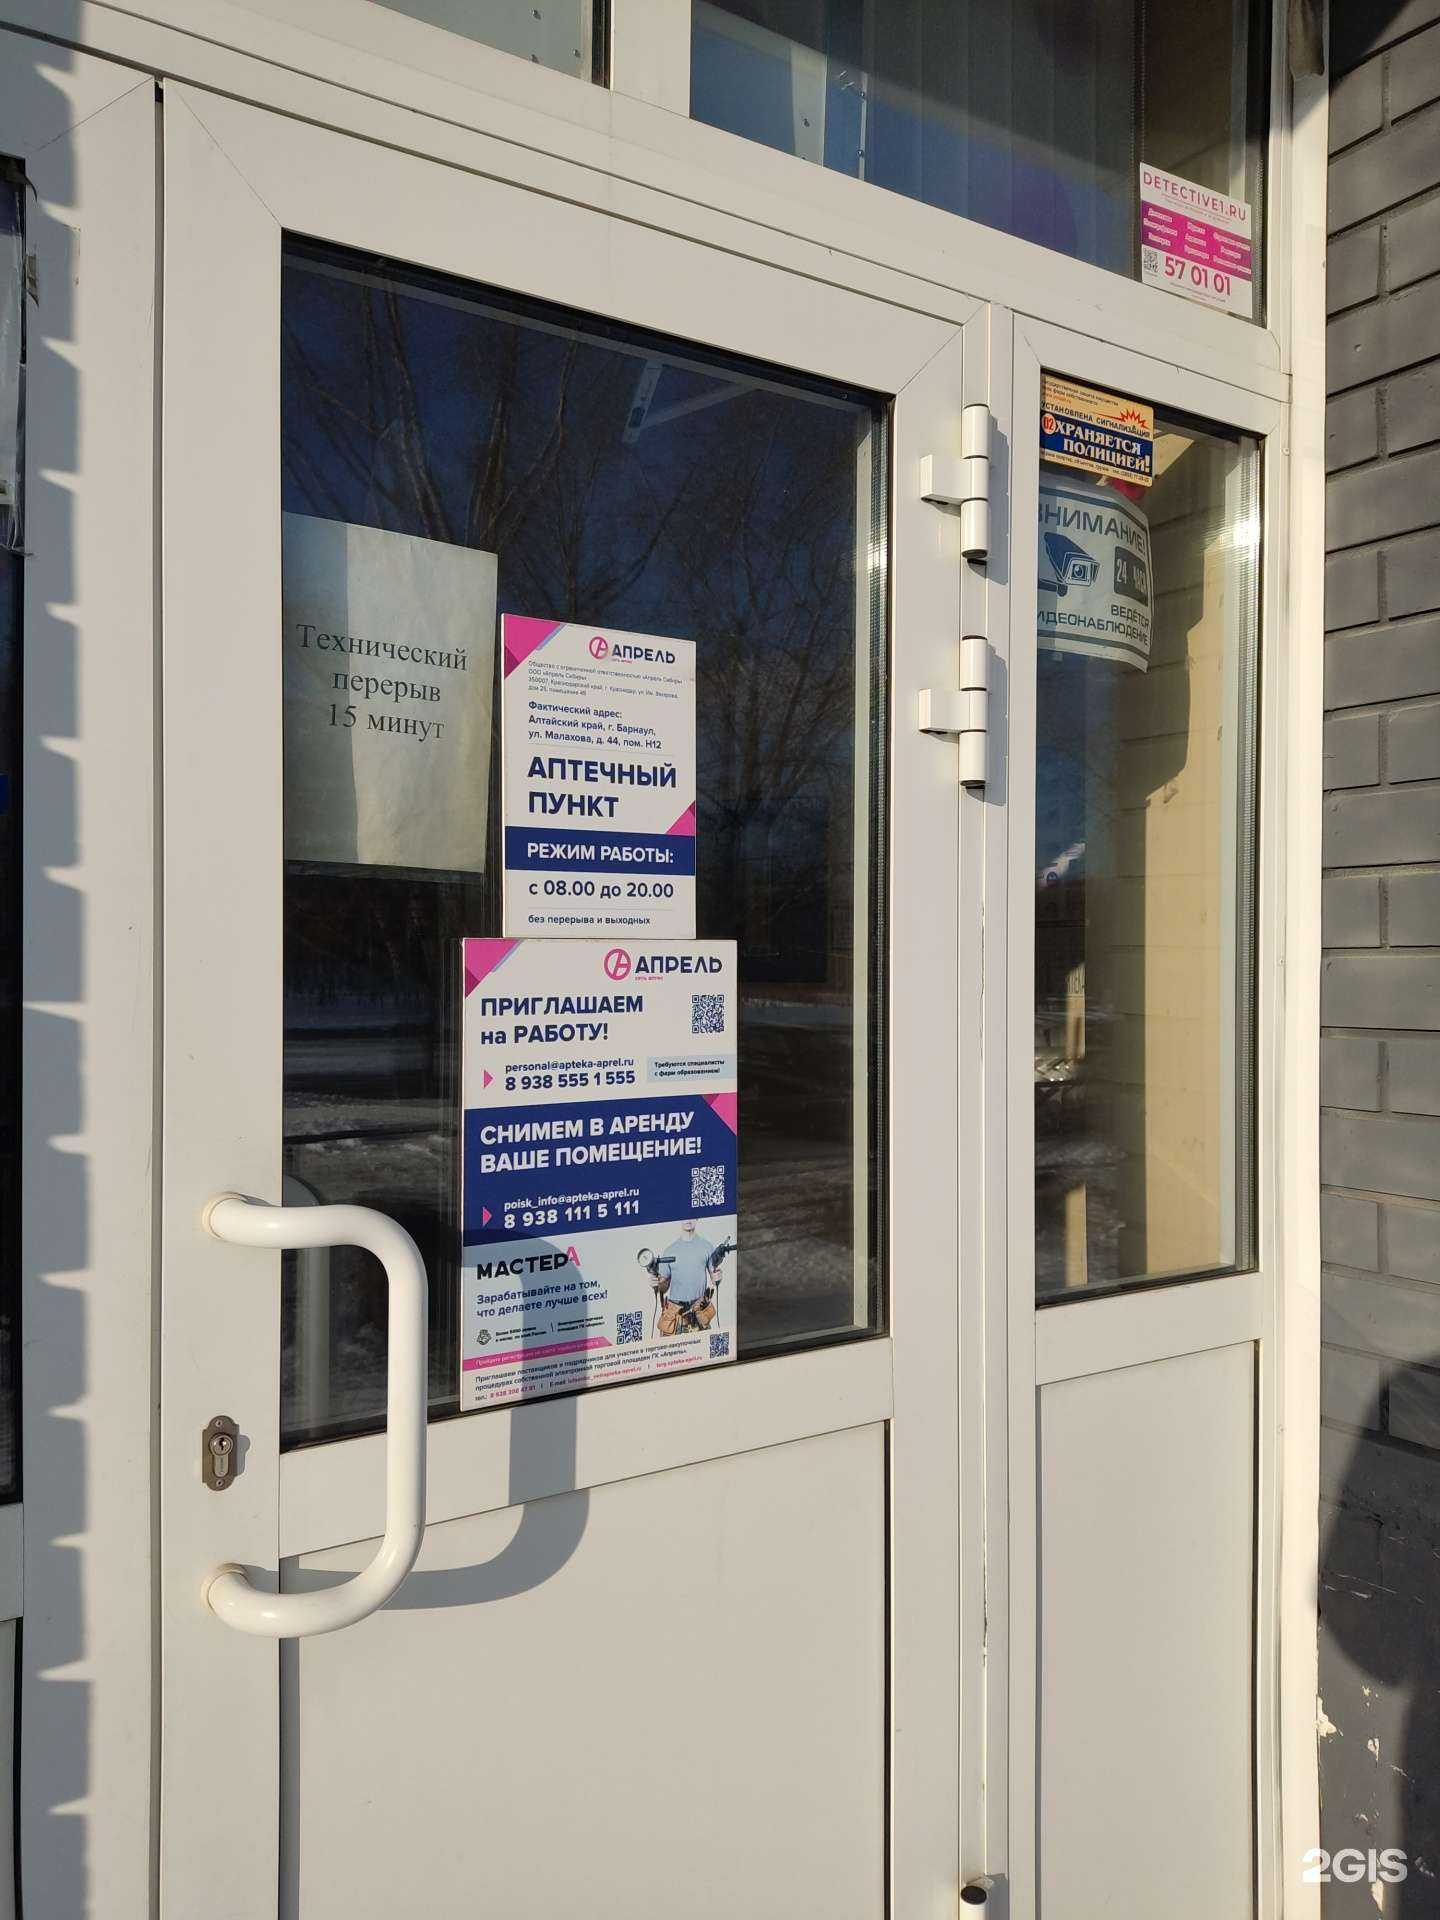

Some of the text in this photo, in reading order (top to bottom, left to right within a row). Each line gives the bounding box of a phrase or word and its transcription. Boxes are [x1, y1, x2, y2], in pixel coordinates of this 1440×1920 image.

[1144, 172, 1246, 221] DETECTIVE1.RU
[1164, 256, 1186, 280] 57
[1191, 265, 1208, 288] 01
[1214, 272, 1232, 296] 01
[1041, 402, 1151, 438] УСТАНОВЛЕНА СИГНАЛИЗАЦИЯ
[1064, 439, 1151, 474] ПОЛИЦИЕЙ!
[1116, 558, 1127, 584] 24
[1037, 611, 1149, 646] ИДЕОНАБЛЮДЕНИЕ
[296, 623, 468, 670] Технический
[611, 643, 676, 665] АПРЕЛЬ
[333, 672, 441, 703] перерыв
[328, 704, 445, 742] 15 минут
[528, 700, 622, 720] Фактический адрес:
[528, 714, 657, 736] Алтайский край, г. Барнаул,
[528, 730, 662, 750] ул. Малахова, д. 44, пом. Н12
[528, 756, 677, 788] АПТЕЧНЫЙ
[528, 792, 619, 818] ПУНКТ
[528, 842, 674, 864] РЕЖИМ РАБОТЫ:
[529, 880, 674, 899] с 08.00 до 20.00
[528, 914, 650, 926] без перерыва и выходных
[634, 956, 722, 974] АПРЕЛЬ
[481, 996, 643, 1016] ПРИГЛАШАЕМ
[481, 1024, 608, 1045] на РАБОТУ!
[505, 1058, 634, 1074] personal@apteka-aprel.ru
[505, 1070, 636, 1091] 8 938 555 1 555
[480, 1112, 694, 1145] СНИМЕМ В АРЕНДУ
[480, 1137, 702, 1174] ВАШЕ ПОМЕЩЕНИЕ!
[504, 1188, 640, 1212] poisk_info@apteka-aprel.ru
[504, 1200, 640, 1229] 8 938 111 5 111
[476, 1246, 581, 1280] МАСТЕРА
[477, 1280, 600, 1305] Зарабатывайте на том,
[477, 1290, 608, 1318] что делаете лучше всех!
[476, 1371, 516, 1384] Приглашаем
